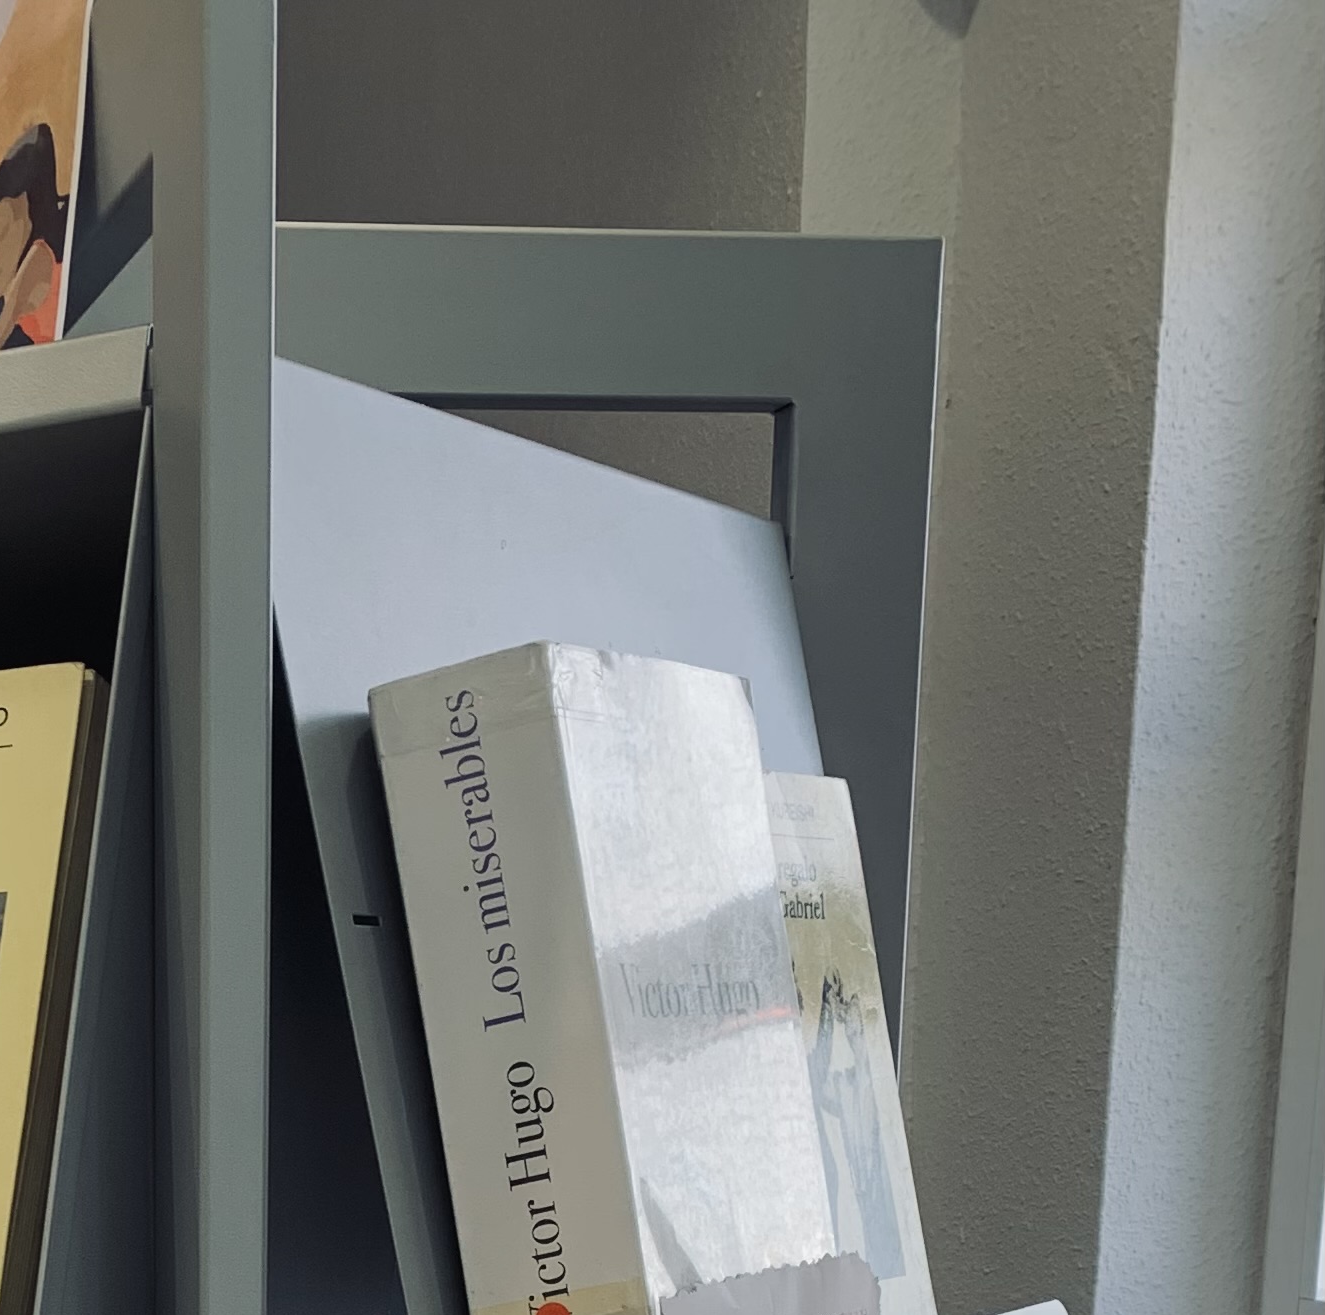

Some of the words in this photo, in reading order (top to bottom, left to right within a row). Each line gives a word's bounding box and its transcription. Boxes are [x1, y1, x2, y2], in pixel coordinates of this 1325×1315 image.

[440, 689, 513, 936] miserables
[780, 891, 825, 920] Gabriel
[483, 943, 528, 1032] Los
[506, 1061, 555, 1193] Hugo
